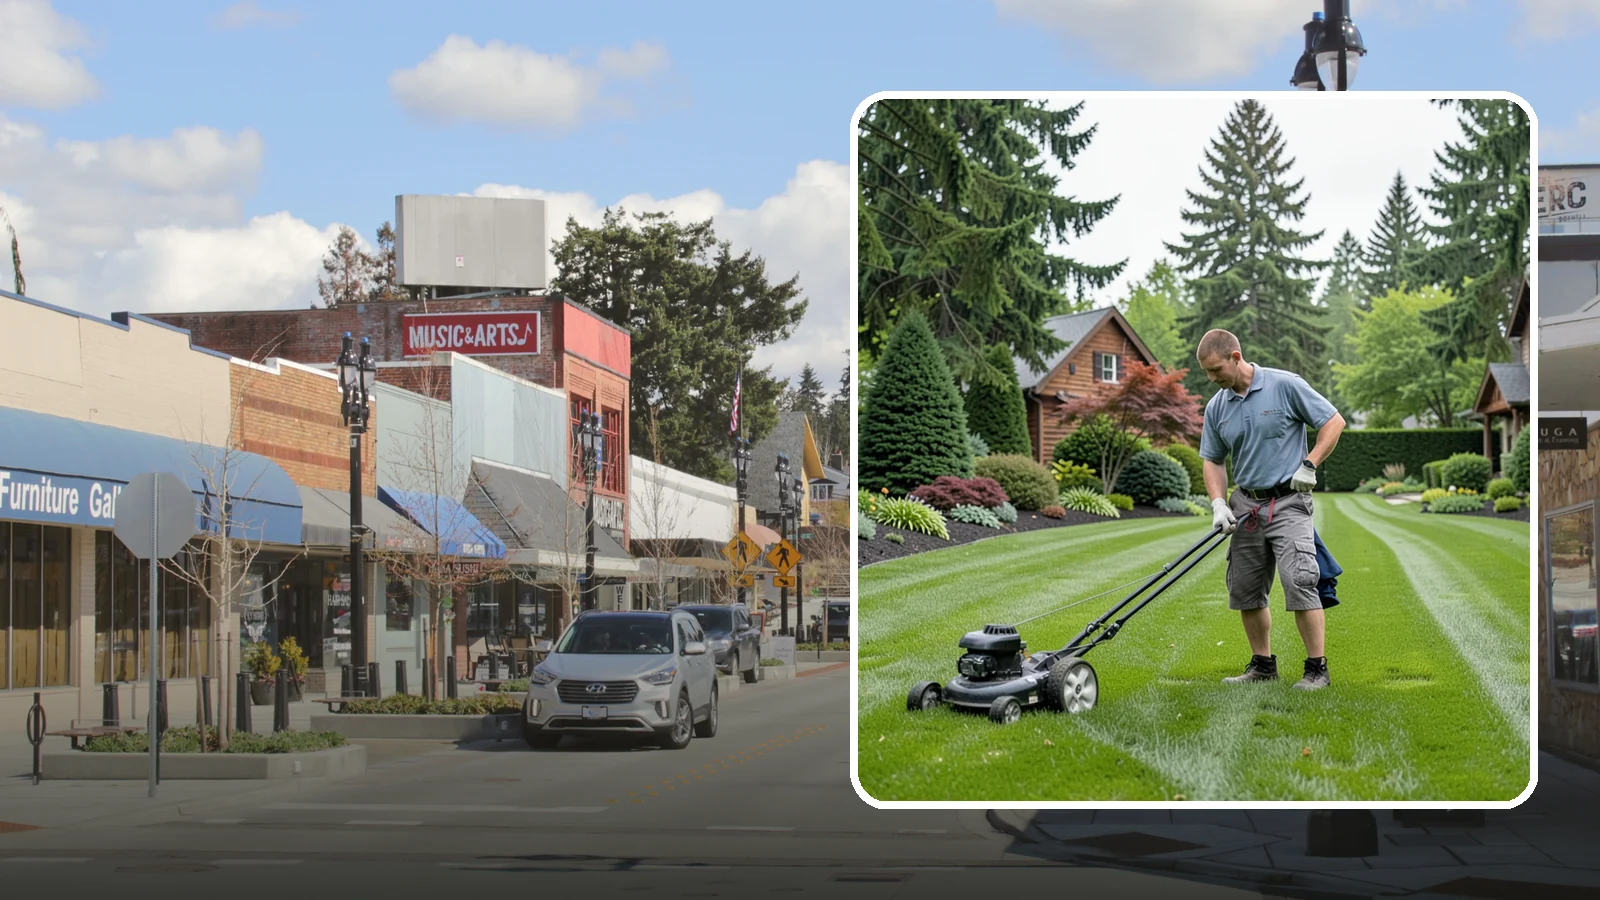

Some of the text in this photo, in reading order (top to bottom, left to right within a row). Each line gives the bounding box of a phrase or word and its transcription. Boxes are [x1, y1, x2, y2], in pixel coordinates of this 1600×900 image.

[0, 471, 122, 519] Furniture Gal
[453, 563, 479, 574] SUSHI
